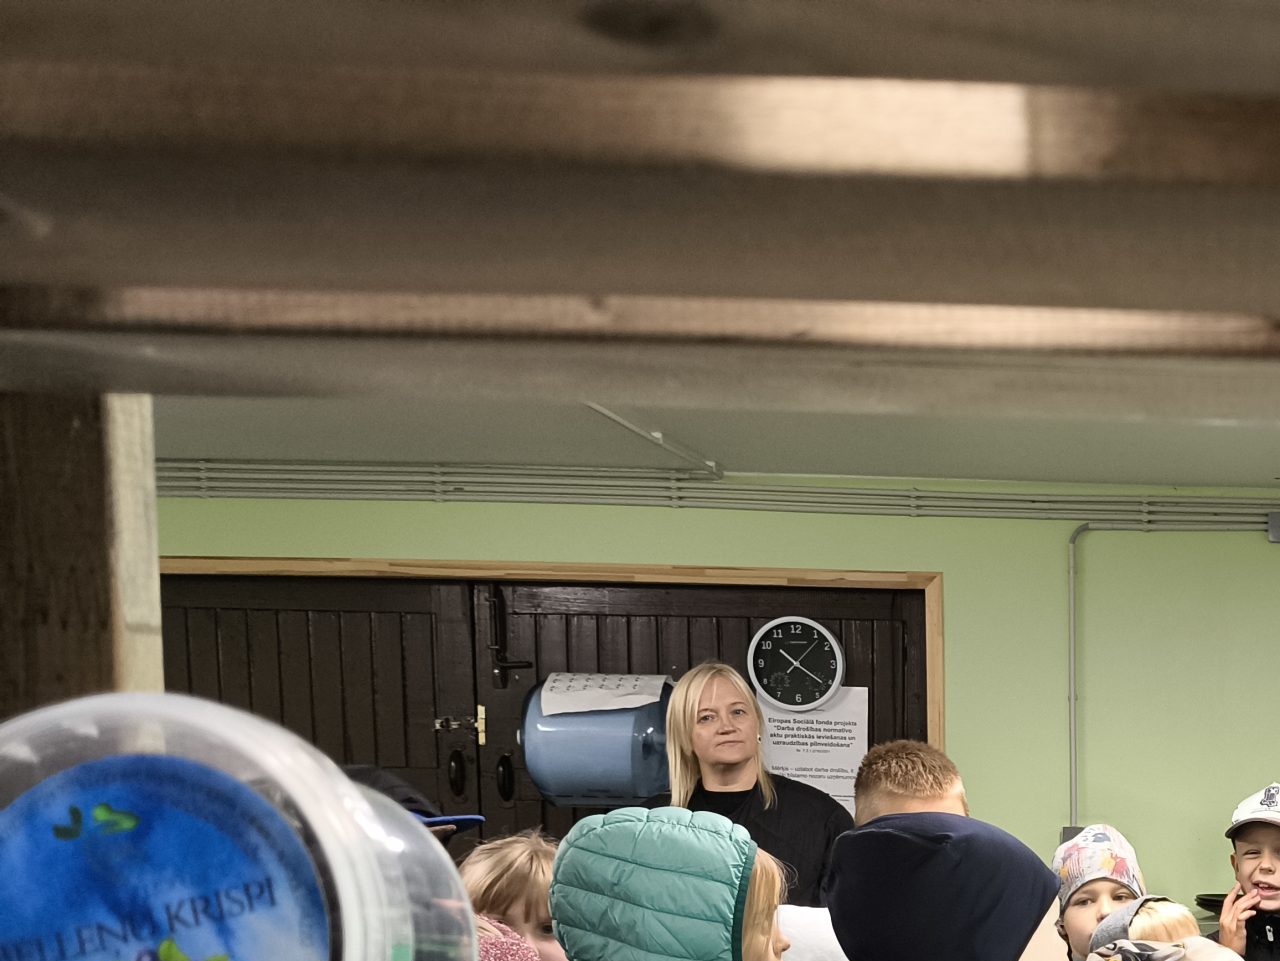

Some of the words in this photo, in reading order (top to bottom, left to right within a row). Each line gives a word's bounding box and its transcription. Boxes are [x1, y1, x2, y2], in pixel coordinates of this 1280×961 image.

[773, 630, 783, 638] 11
[790, 625, 802, 634] 12
[813, 630, 818, 639] 1
[761, 641, 772, 650] 10
[824, 642, 830, 651] 2
[758, 659, 765, 668] 9
[830, 660, 836, 669] 3
[796, 694, 802, 703] 6
[164, 876, 277, 934] KRISPI
